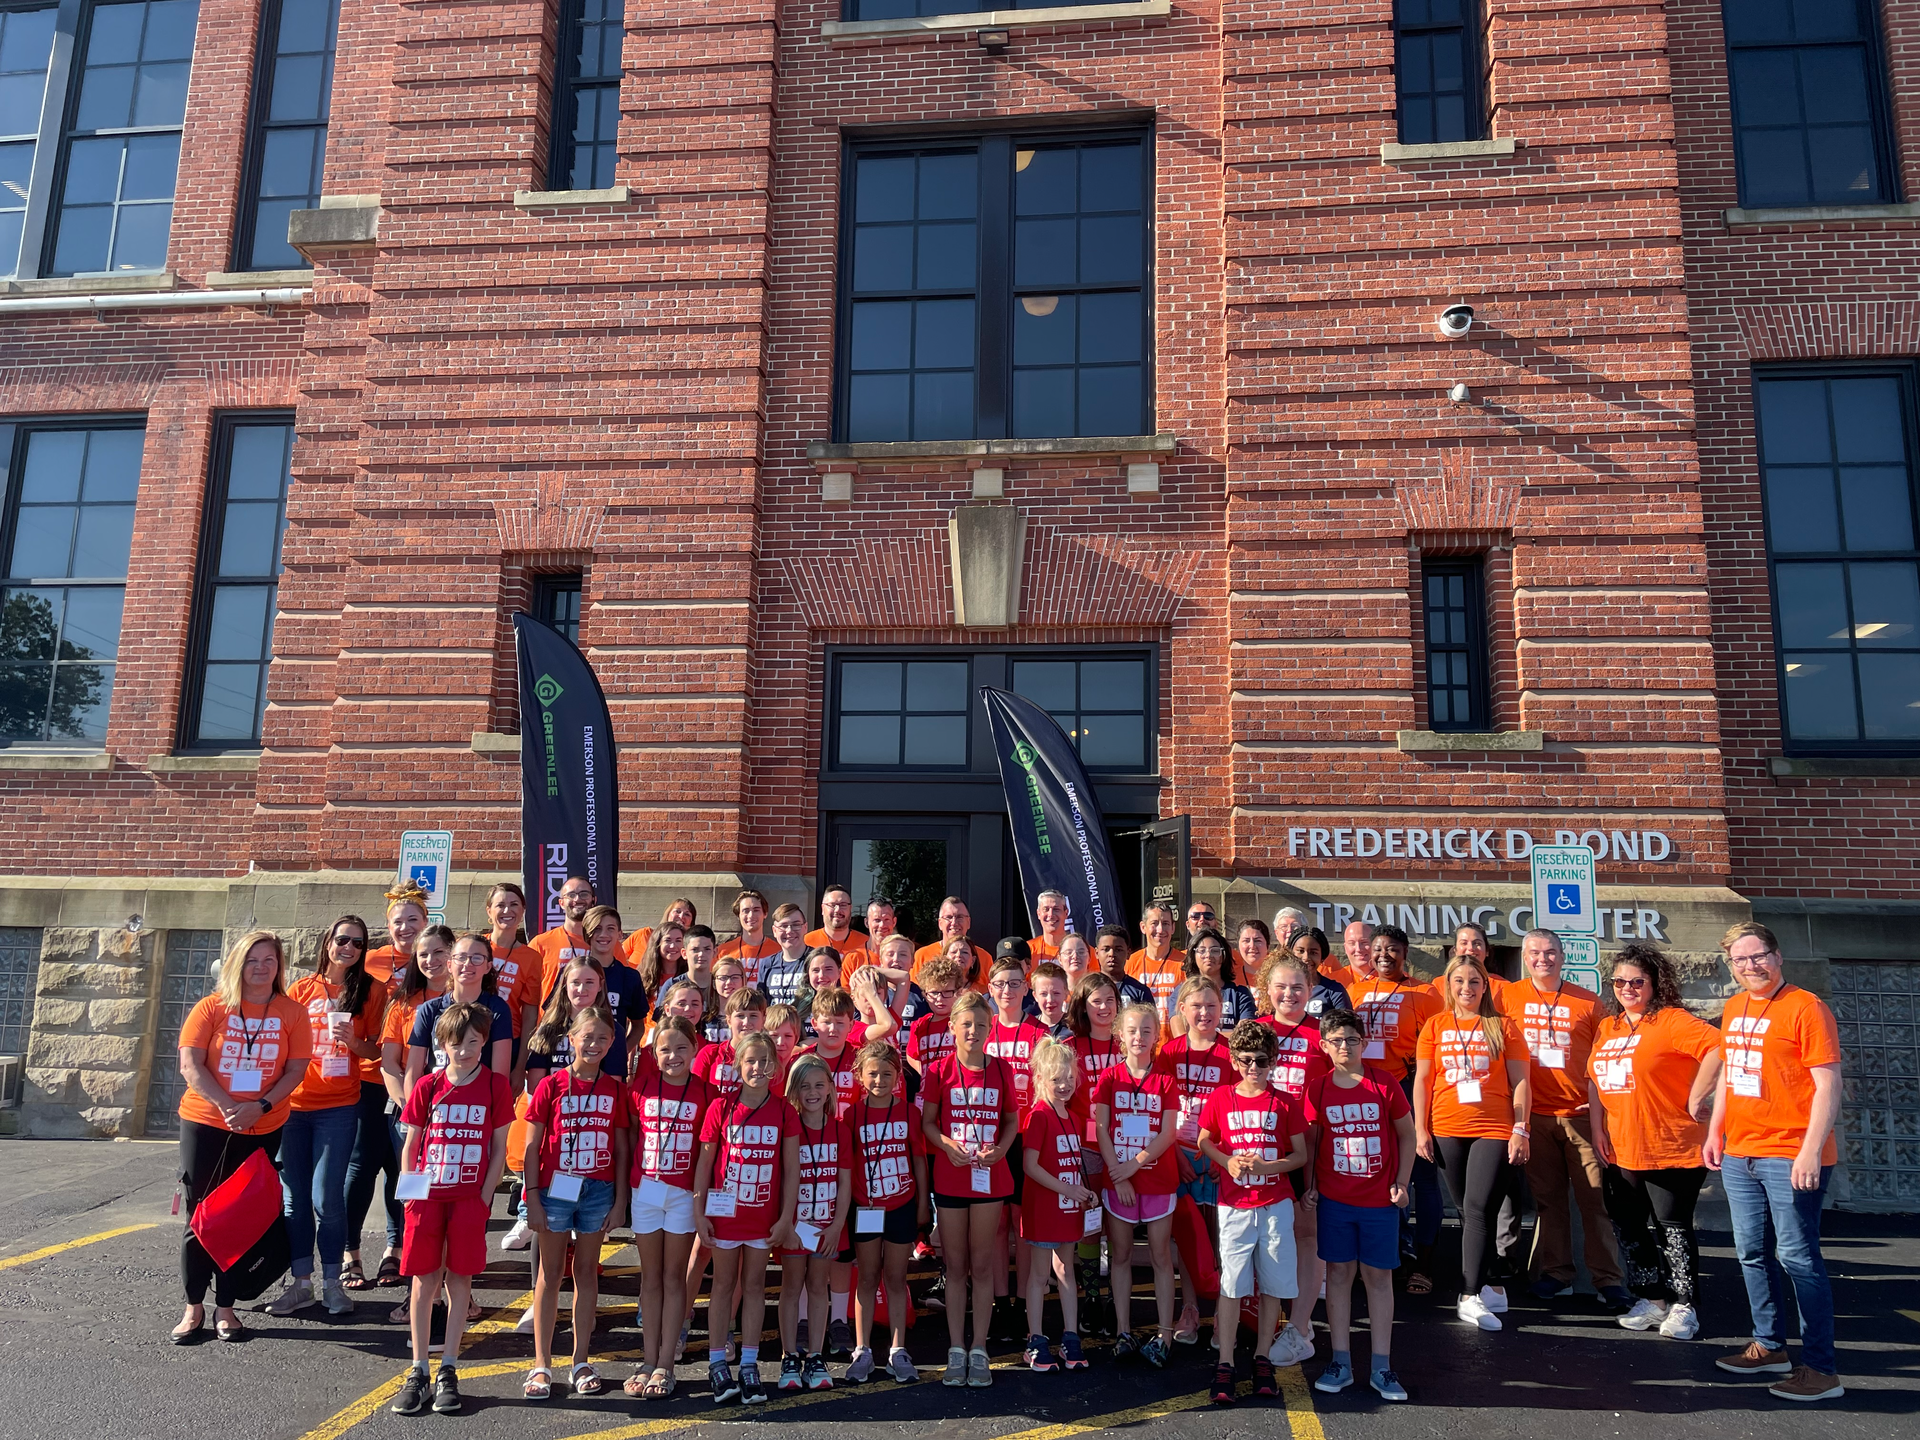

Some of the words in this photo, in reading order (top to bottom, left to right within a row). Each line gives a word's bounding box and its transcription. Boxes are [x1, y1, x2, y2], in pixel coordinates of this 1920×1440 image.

[542, 711, 558, 796] GREENLEE
[583, 725, 594, 775] EMERSON
[585, 777, 597, 853] PROFESSIONAL
[1026, 774, 1051, 855] GREENLEE
[404, 839, 447, 849] RESERVED
[1289, 828, 1495, 859] FREDERICK
[406, 852, 443, 862] PARKING
[1065, 782, 1084, 829] EMERSON
[1077, 830, 1099, 902] PROFESSIONAL
[1092, 903, 1104, 931] TOOL
[1536, 854, 1589, 866] RESERVED
[1540, 869, 1586, 881] PARKING
[546, 843, 567, 932] RIDGI
[1309, 903, 1497, 936] TRAINING
[1509, 906, 1663, 940] CTER
[1571, 942, 1591, 951] FINE
[1219, 1017, 1234, 1025] TEM
[1523, 1017, 1536, 1025] WE
[226, 1030, 241, 1038] WE
[1441, 1044, 1453, 1052] WE
[551, 1055, 564, 1063] WE
[1282, 1054, 1306, 1064] STEM
[951, 1109, 965, 1118] WE
[975, 1110, 998, 1120] STEM
[561, 1118, 577, 1127] WE
[589, 1117, 610, 1127] STEM
[643, 1121, 657, 1129] WE
[430, 1128, 443, 1138] WE
[456, 1129, 482, 1139] STEM
[1331, 1126, 1344, 1134] WE
[1356, 1123, 1380, 1132] STEM
[1230, 1135, 1244, 1144] WE
[1254, 1133, 1277, 1143] STEM
[887, 1144, 906, 1153] STEM
[1058, 1157, 1072, 1166] WE
